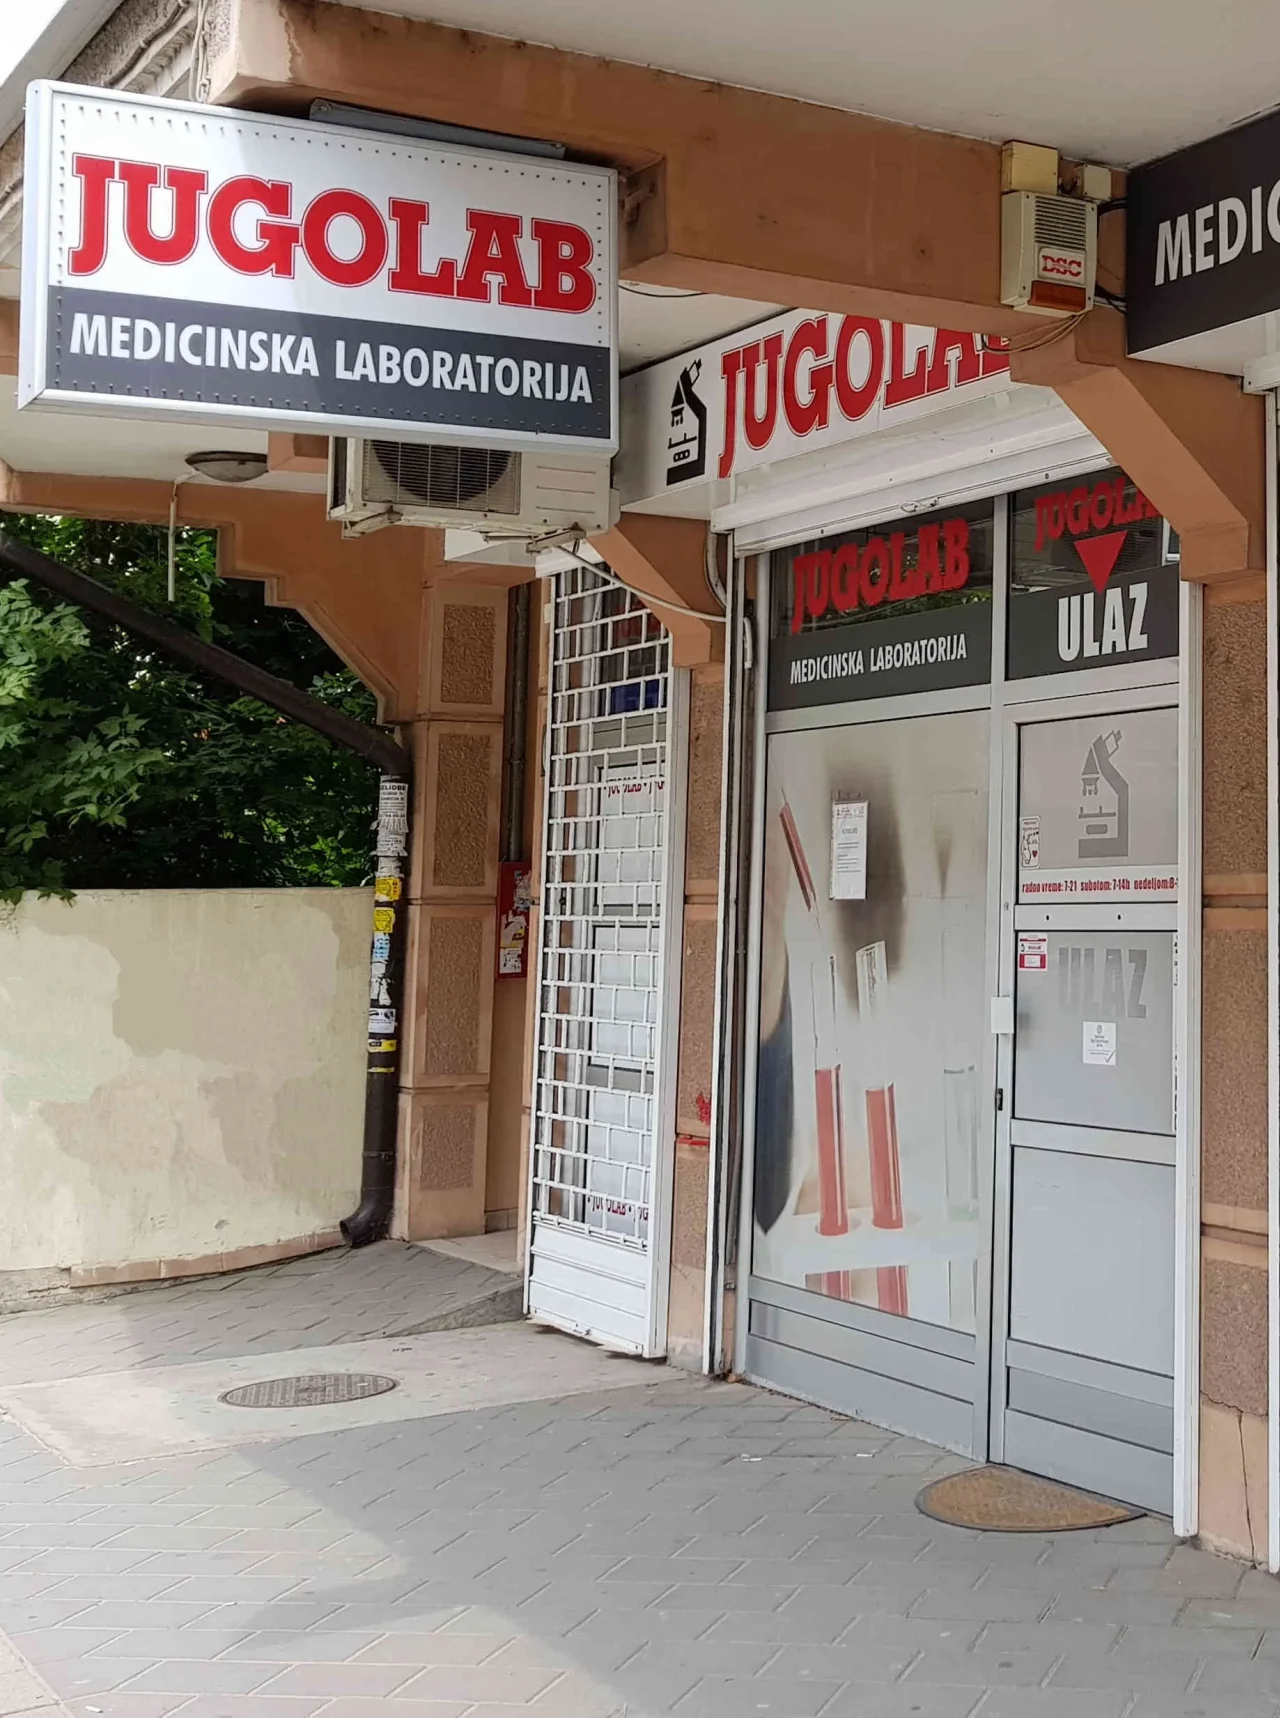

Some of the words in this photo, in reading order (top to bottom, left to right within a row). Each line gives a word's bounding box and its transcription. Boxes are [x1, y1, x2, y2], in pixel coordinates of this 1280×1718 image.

[67, 152, 598, 314] JUGOLAB
[1042, 255, 1082, 277] DSC
[69, 313, 319, 377] MEDICINSKA
[335, 340, 593, 404] LABORATORIJA
[718, 314, 1010, 478] JUGOLA
[791, 518, 970, 633] JUGOLAB
[790, 657, 864, 685] MEDICINSKA
[870, 633, 967, 674] LABORATORIJA
[1057, 582, 1149, 662] ULAZ
[1022, 881, 1041, 893] radno
[1041, 882, 1064, 893] vreme:
[1064, 880, 1078, 892] 7-21
[1080, 878, 1112, 892] subotom:
[1112, 877, 1131, 891] 7-14h
